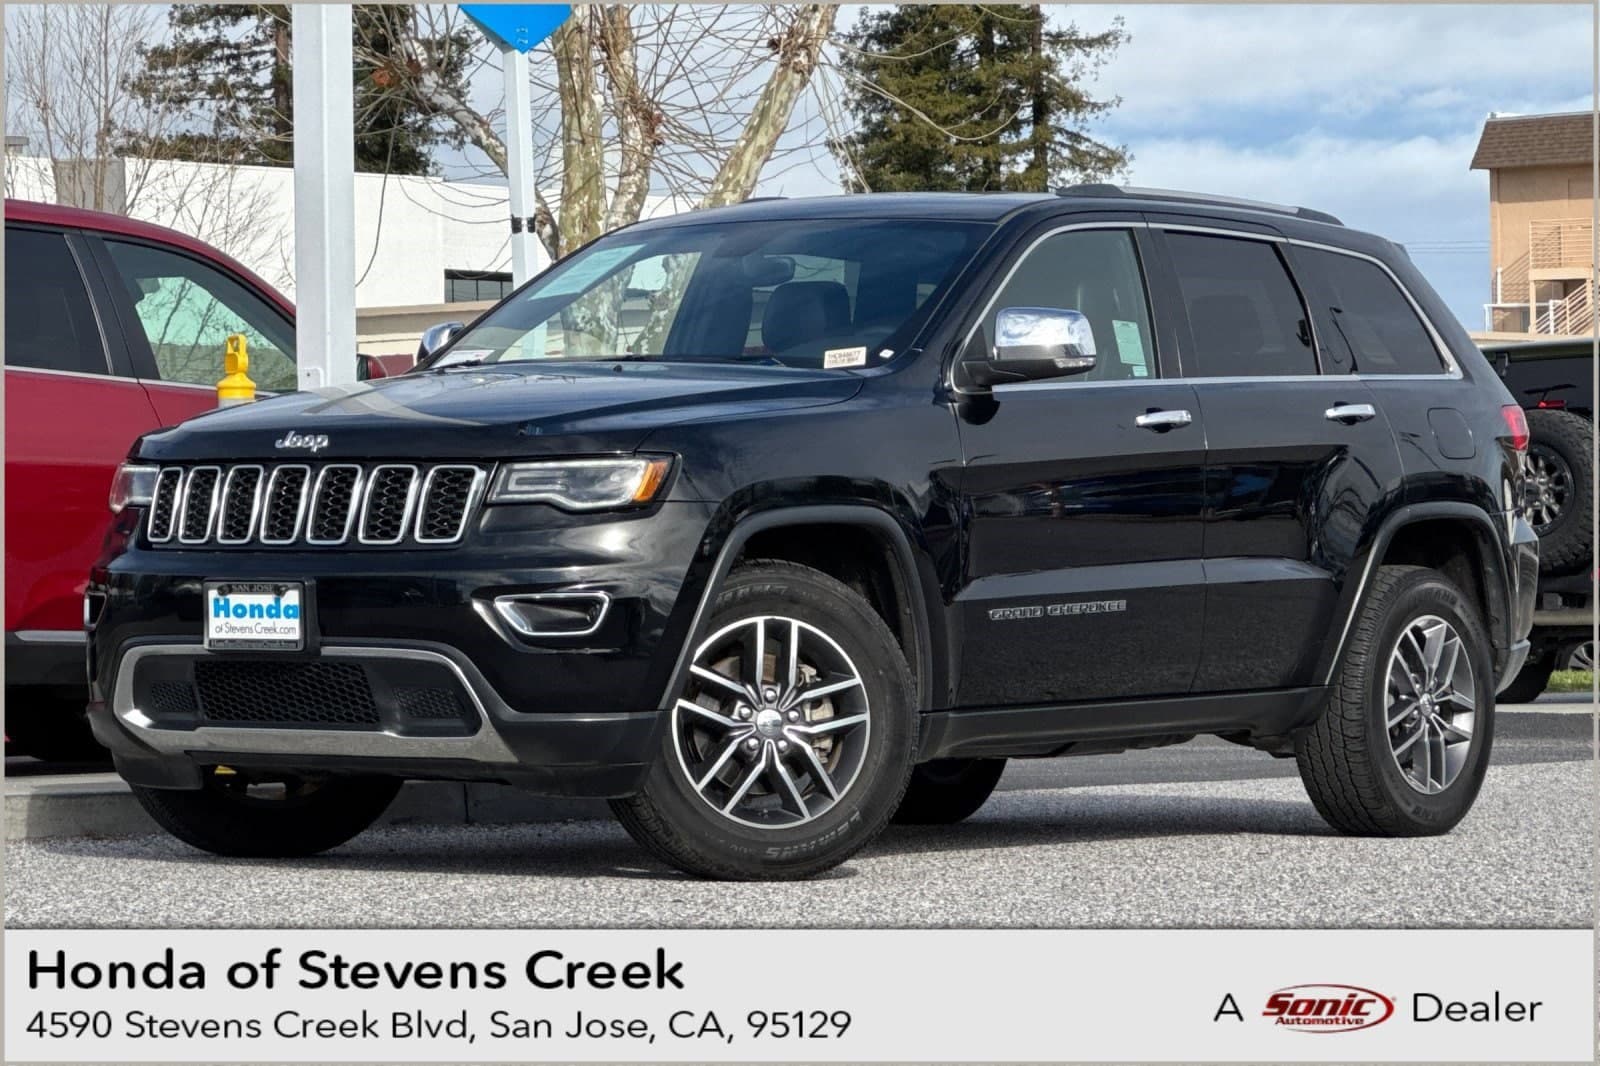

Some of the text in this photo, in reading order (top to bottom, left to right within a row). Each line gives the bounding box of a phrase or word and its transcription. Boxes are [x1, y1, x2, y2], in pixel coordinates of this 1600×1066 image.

[274, 430, 329, 453] Jeep
[232, 583, 249, 592] SAN
[213, 596, 299, 619] Honda
[989, 600, 1127, 621] GRAND CHEROKEE
[215, 625, 223, 633] of
[224, 621, 253, 633] Stevens
